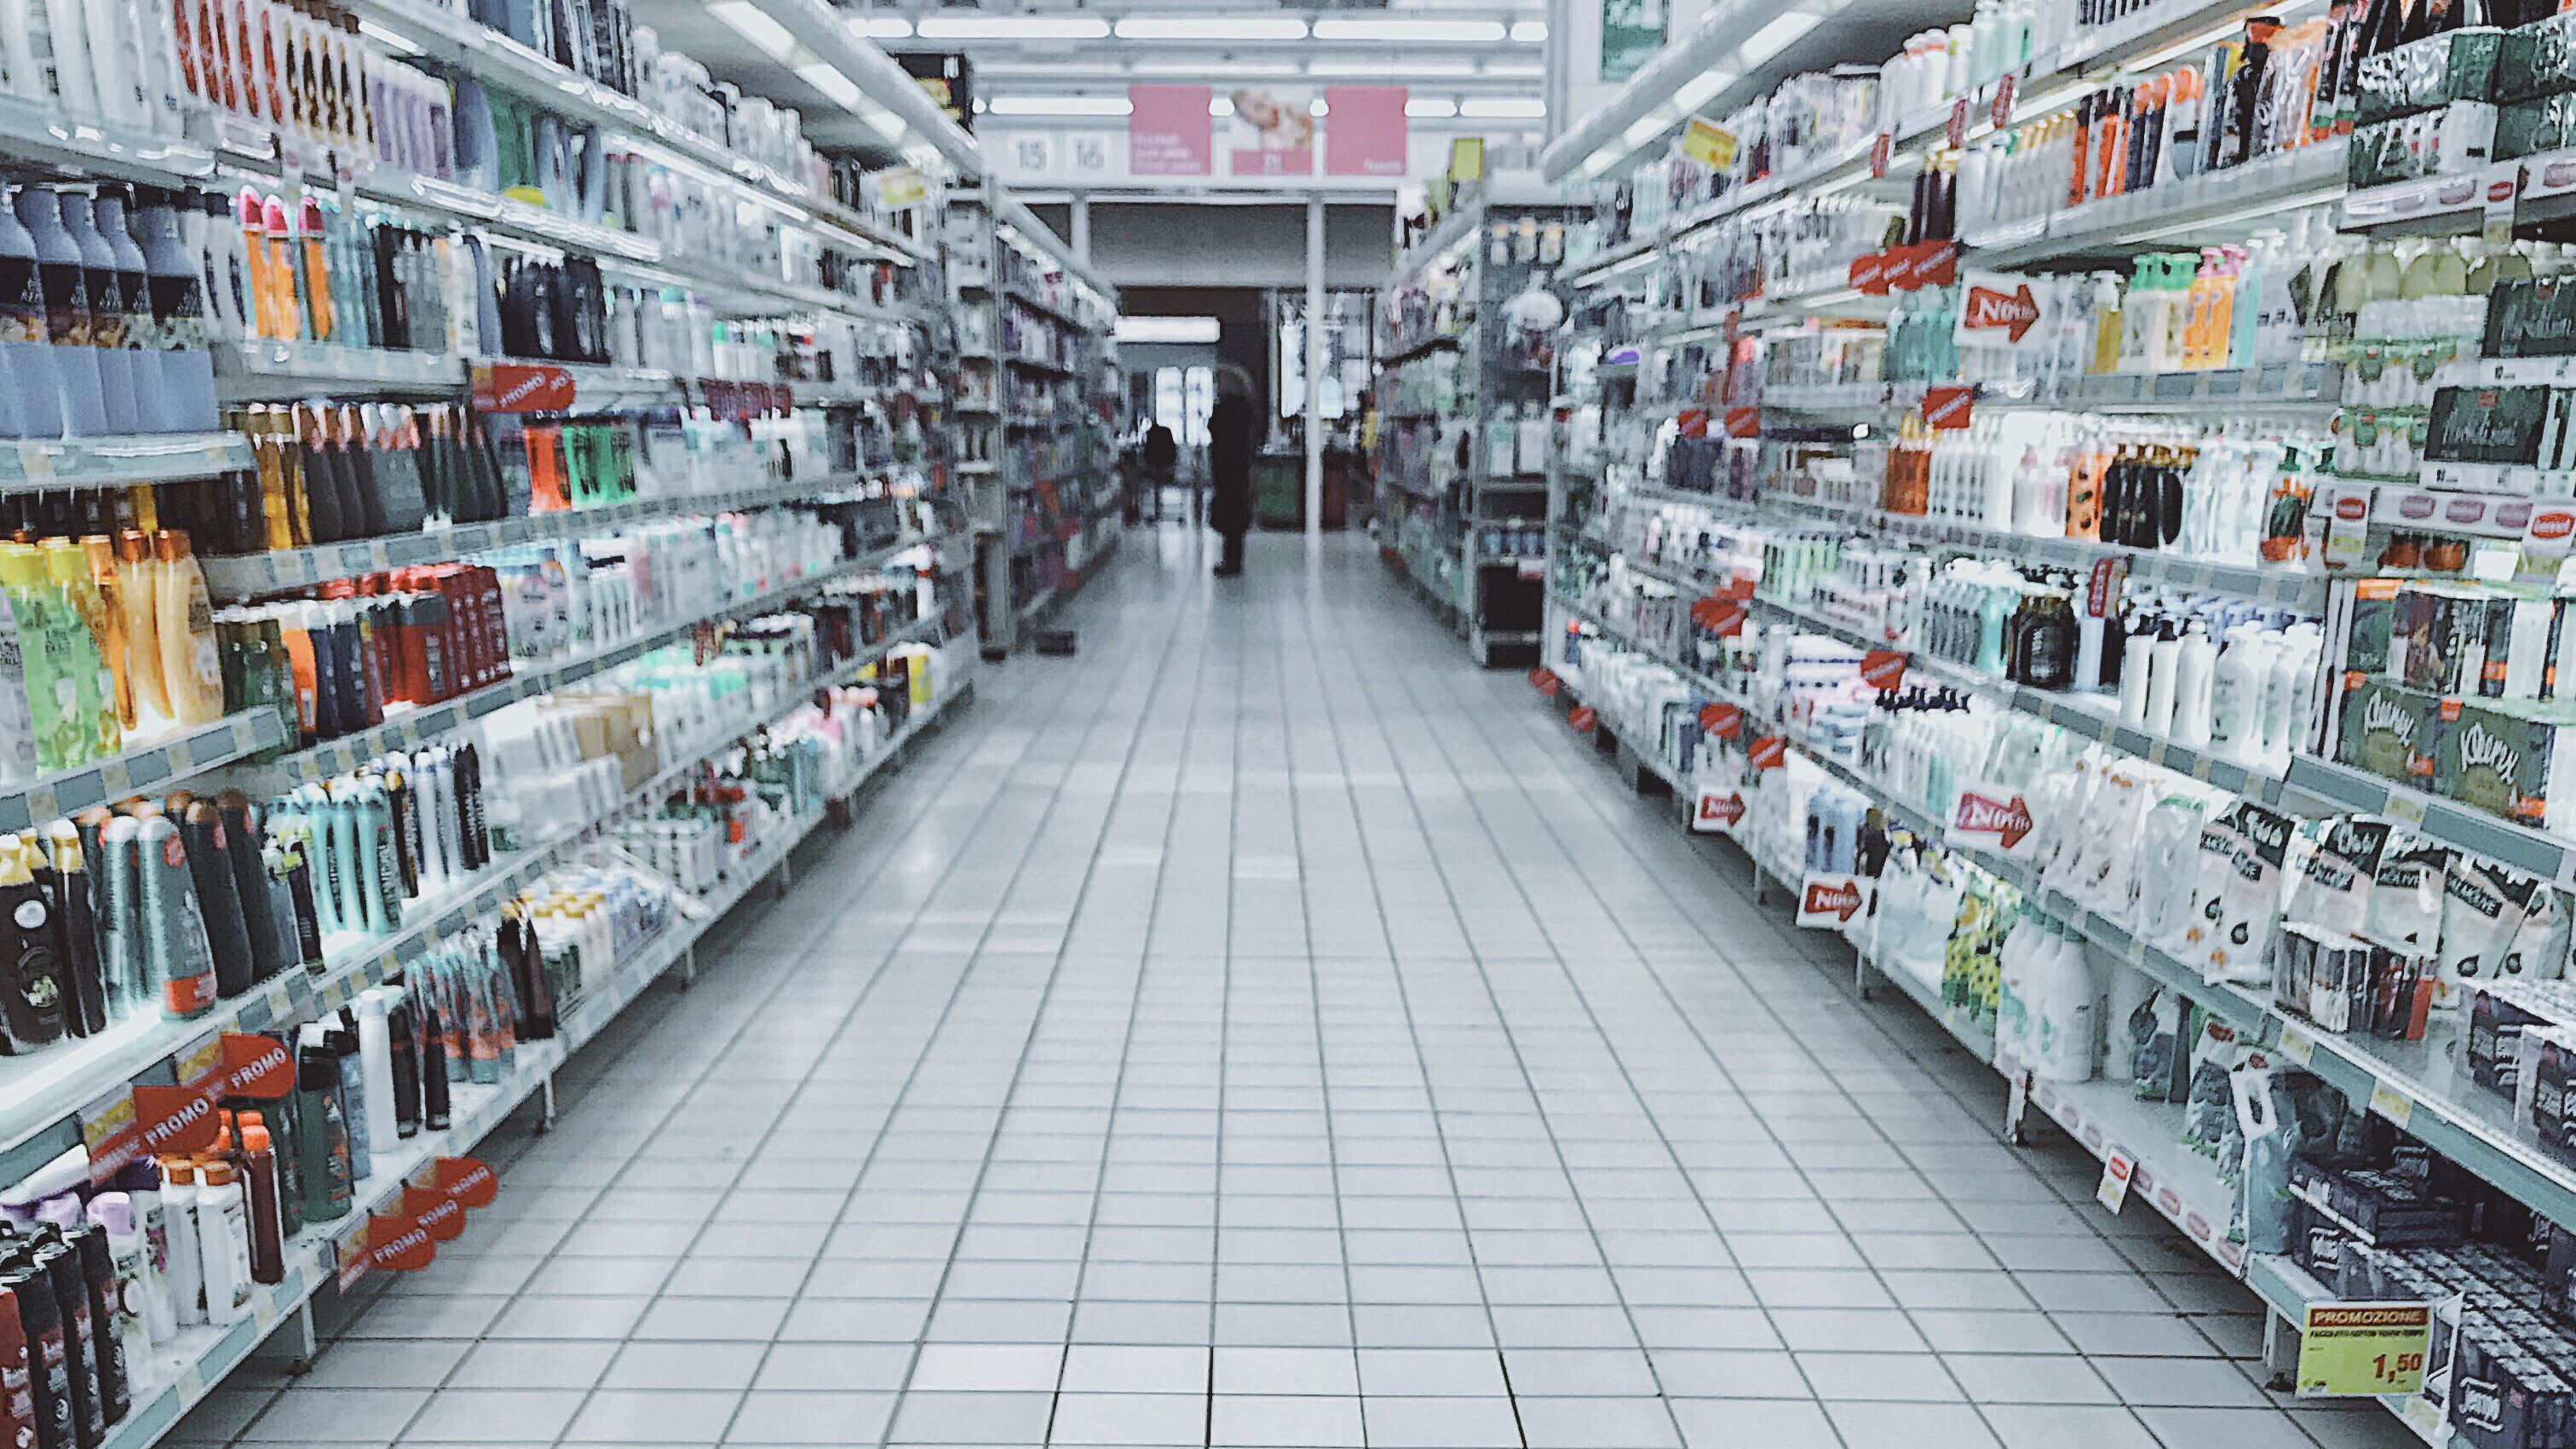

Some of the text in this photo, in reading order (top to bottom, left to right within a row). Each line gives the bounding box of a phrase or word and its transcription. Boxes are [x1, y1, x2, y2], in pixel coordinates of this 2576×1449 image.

[1019, 141, 1047, 170] 15
[1076, 141, 1105, 170] 16
[230, 1046, 287, 1090] PROMO
[144, 1096, 210, 1147] PROMO
[417, 1199, 458, 1227] ROMO
[373, 1227, 427, 1264] PROMO
[2314, 1310, 2421, 1325] PROMOZIONE
[2372, 1352, 2424, 1384] 1,50
